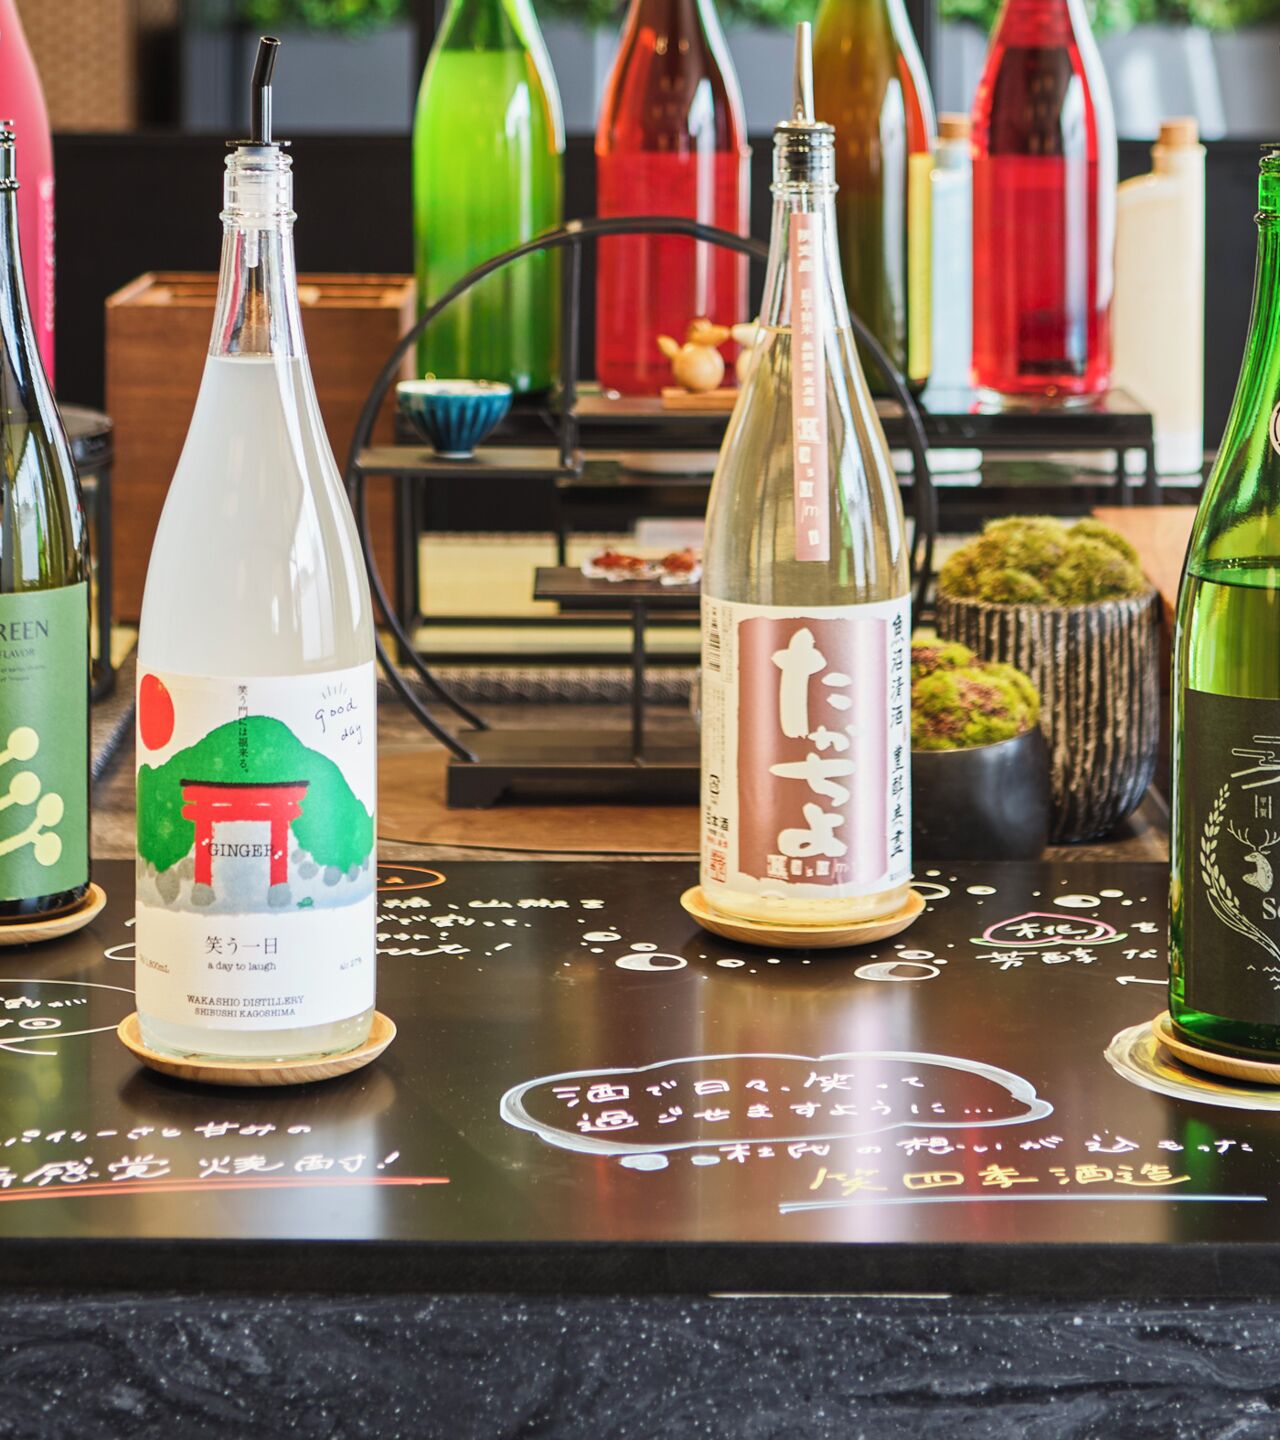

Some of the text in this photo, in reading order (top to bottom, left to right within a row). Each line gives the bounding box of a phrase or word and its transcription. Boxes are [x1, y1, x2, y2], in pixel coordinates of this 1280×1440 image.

[340, 721, 363, 745] day
[208, 842, 276, 858] GINGER
[204, 936, 279, 956] 笑う一日
[207, 961, 277, 973] a day to laugh
[186, 994, 305, 1007] WAKASHIO DISTILLERY
[194, 1007, 296, 1018] SHIBUSHI KAGOSHIMA
[808, 1163, 1191, 1197] 笑四季酒造
